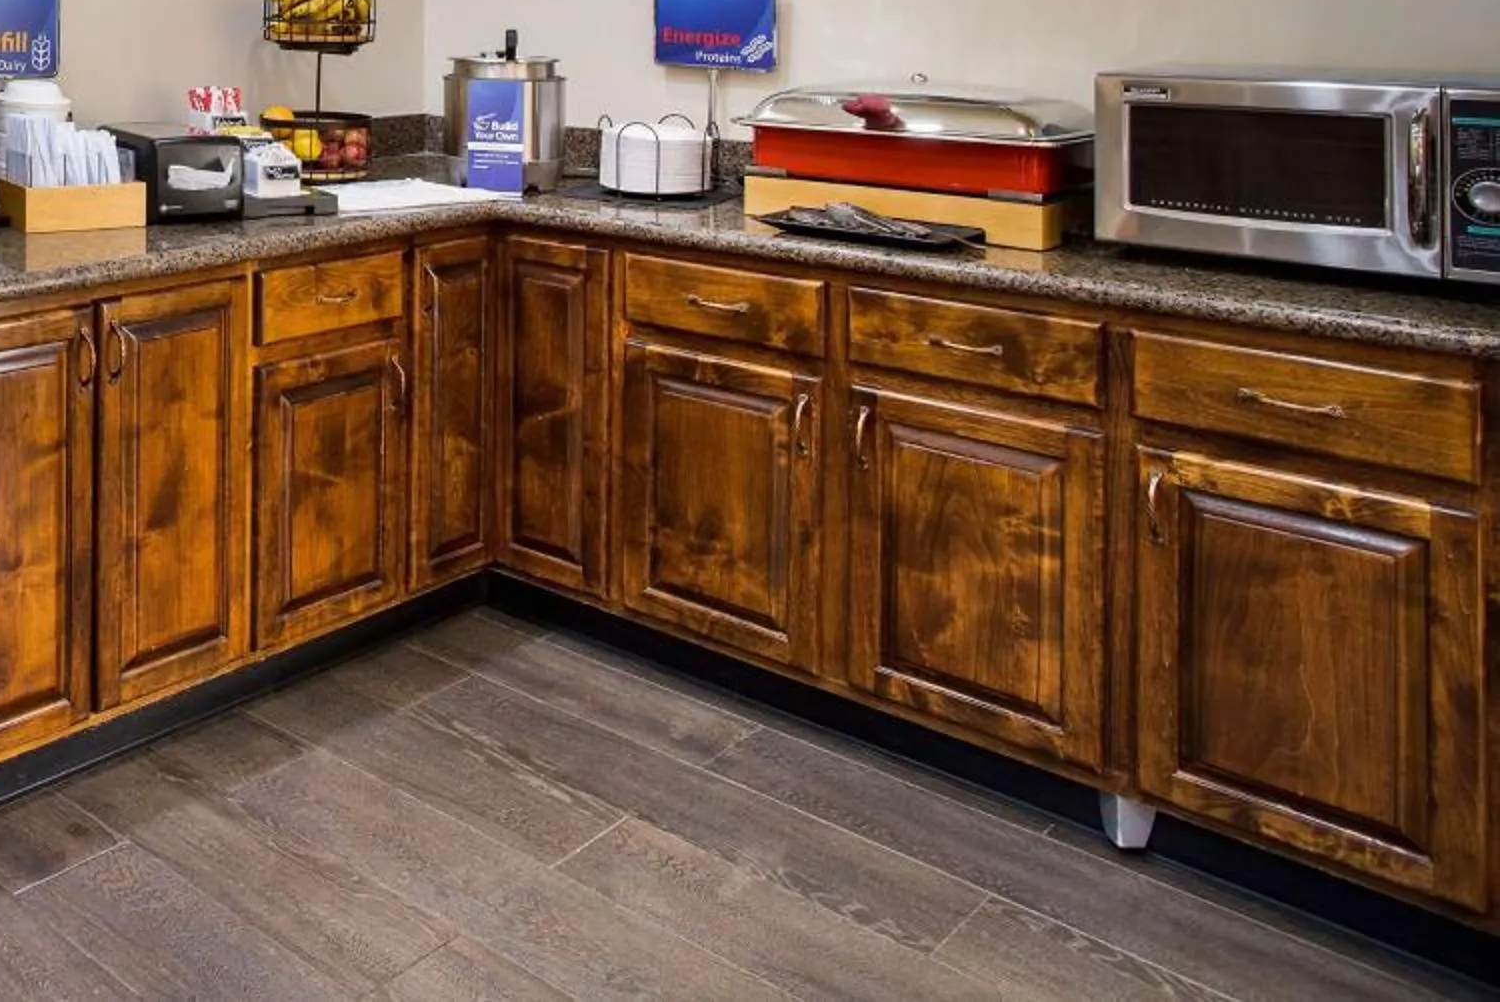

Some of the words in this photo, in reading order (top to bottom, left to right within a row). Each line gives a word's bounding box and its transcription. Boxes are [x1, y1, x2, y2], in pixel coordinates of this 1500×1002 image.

[663, 26, 741, 48] Energize
[695, 50, 742, 64] Proteins
[491, 121, 519, 131] Build
[474, 130, 495, 141] Your
[495, 131, 519, 142] Own
